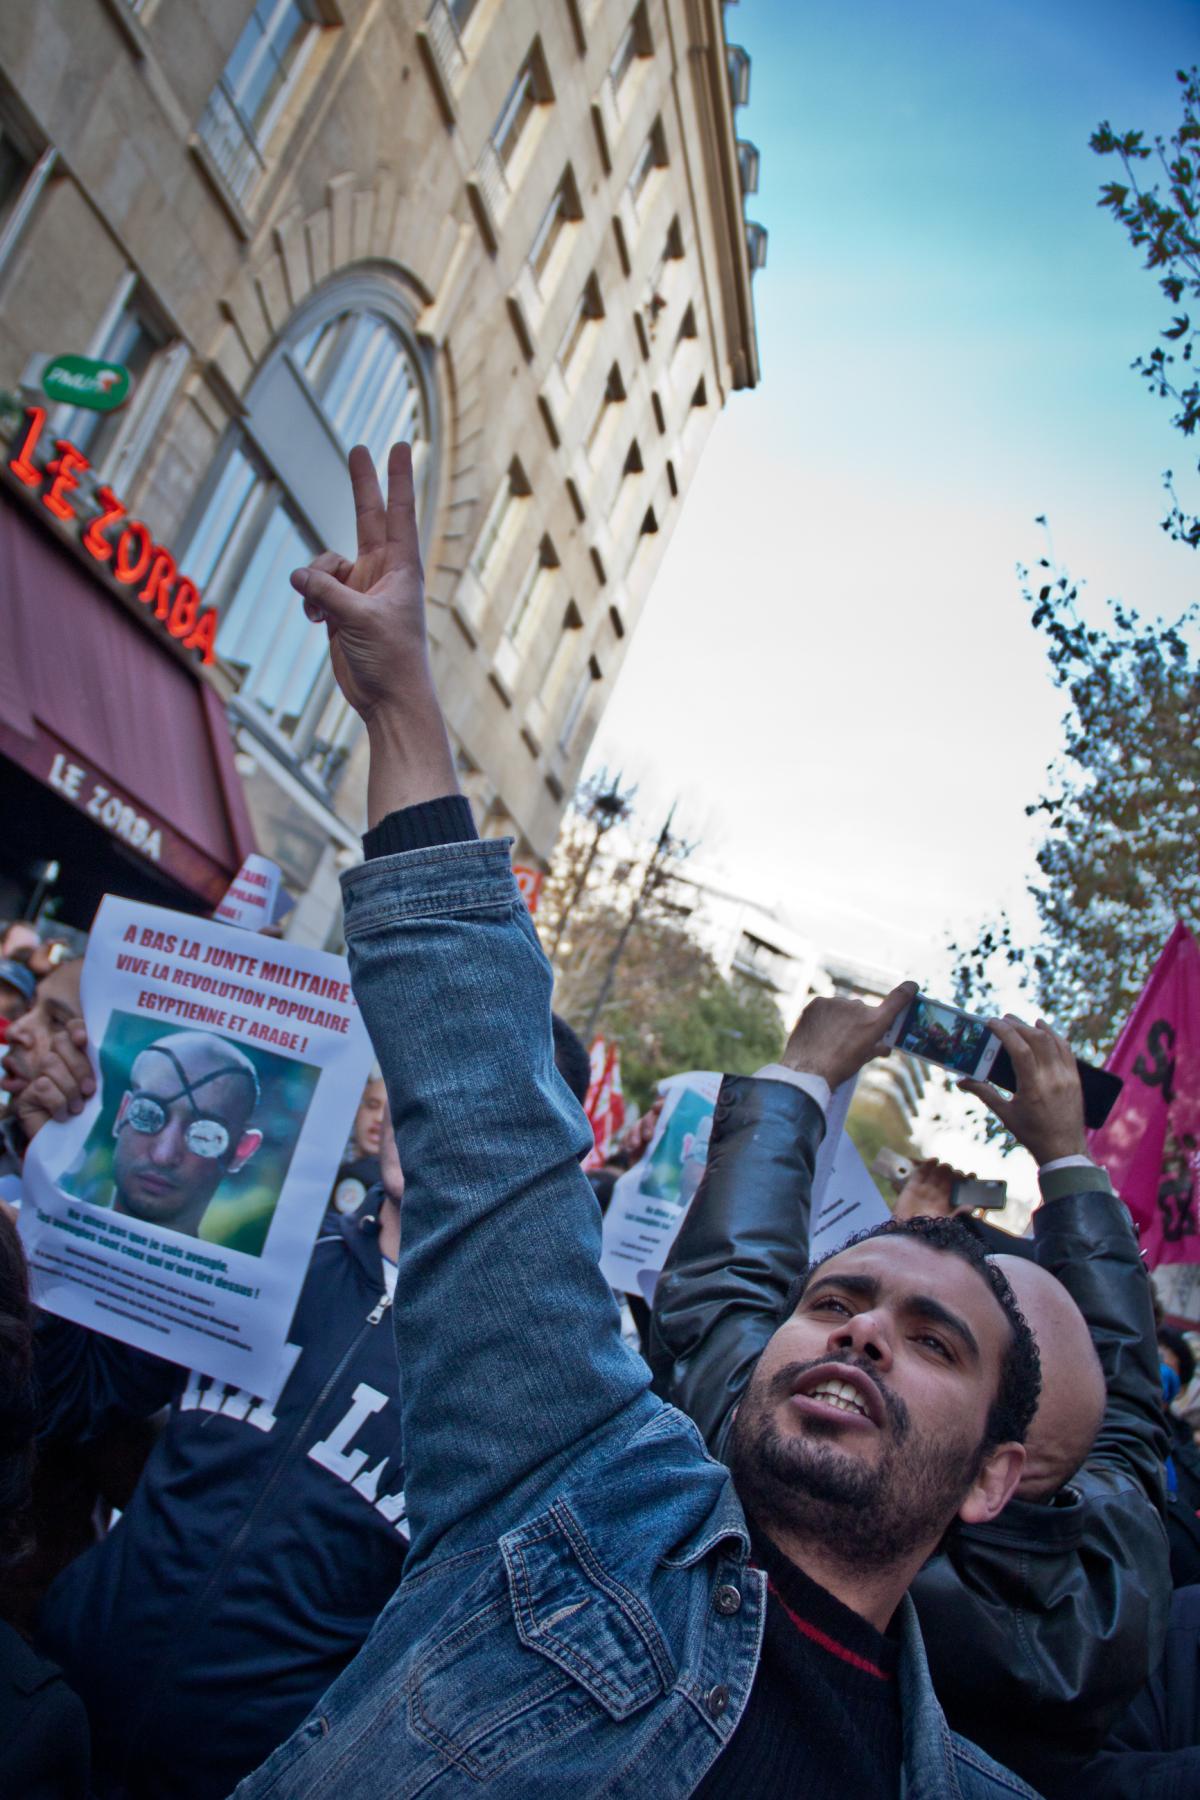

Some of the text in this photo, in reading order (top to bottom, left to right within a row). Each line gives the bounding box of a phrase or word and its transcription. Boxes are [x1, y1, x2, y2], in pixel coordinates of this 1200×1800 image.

[10, 406, 218, 666] LE ZORBA
[48, 753, 162, 862] LE ZORBA
[116, 953, 351, 1035] VIVE LA REVOLUTION POPULAIRE
[123, 924, 351, 1004] A BAS LA JUNTE MILITAIRE
[137, 990, 309, 1054] EGYPTIENNE ET ARABE !
[97, 1235, 120, 1252] sont
[121, 1245, 145, 1261] ceux
[214, 1276, 254, 1298] dessus
[108, 1225, 128, 1239] pas
[128, 1232, 148, 1247] que
[148, 1237, 160, 1251] je
[161, 1243, 184, 1259] suis
